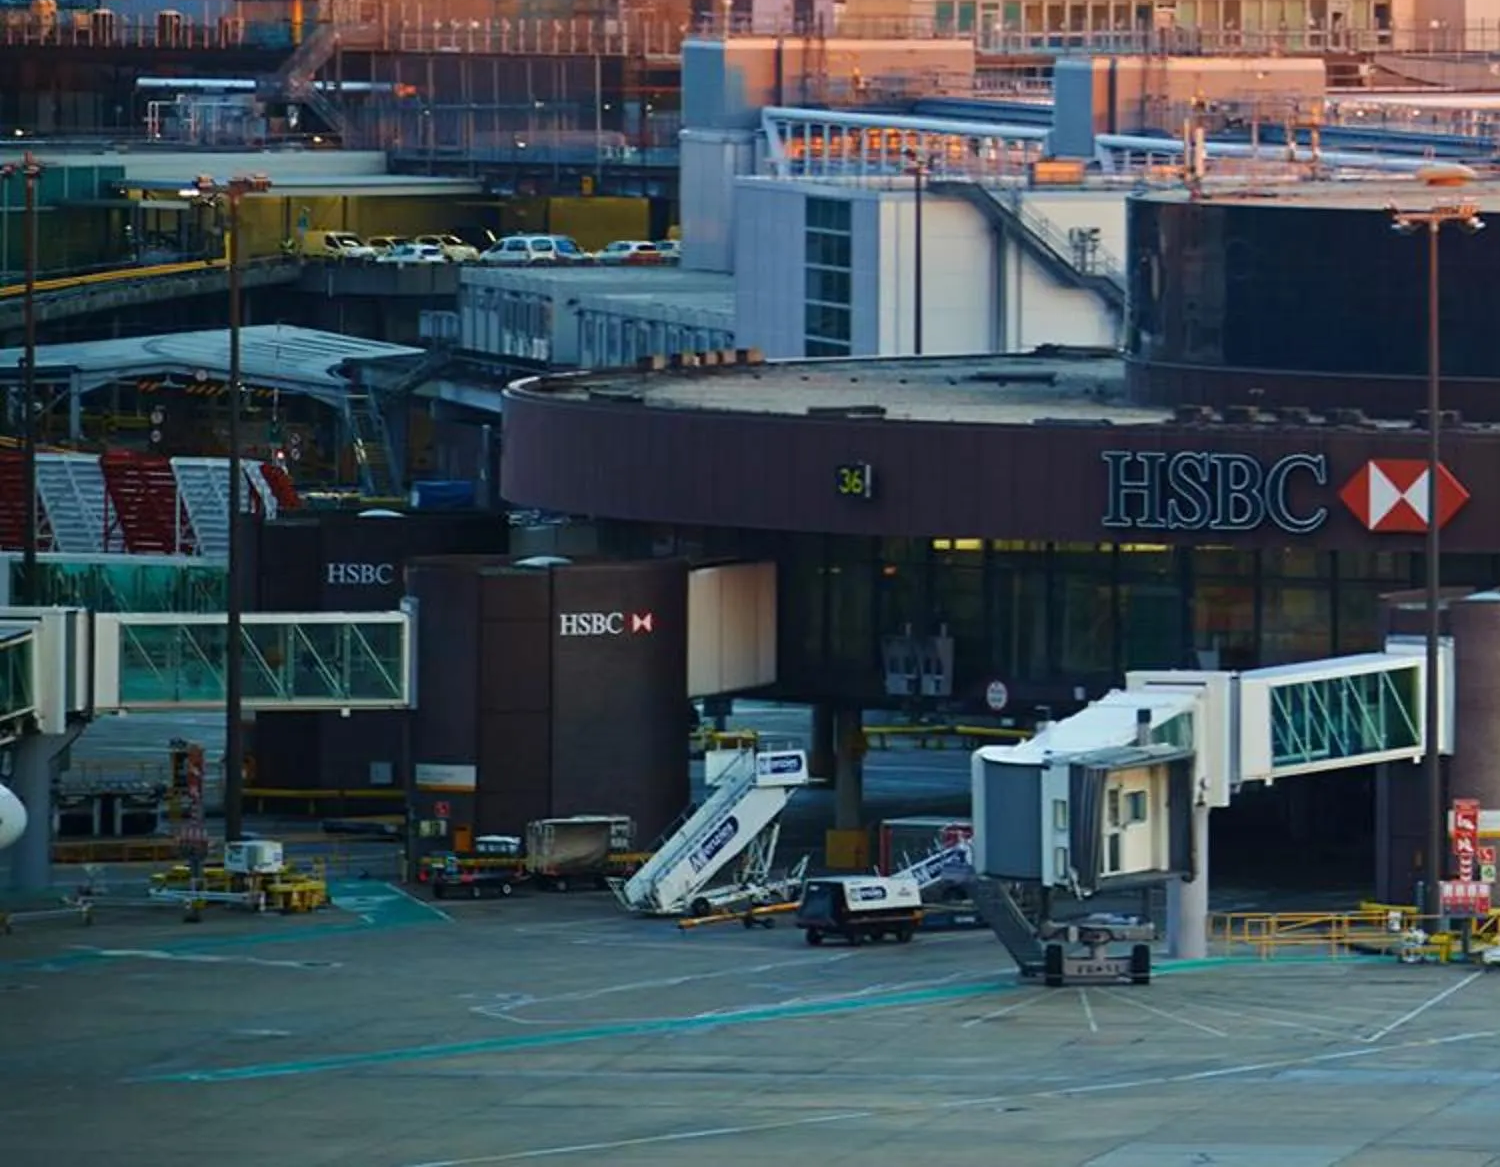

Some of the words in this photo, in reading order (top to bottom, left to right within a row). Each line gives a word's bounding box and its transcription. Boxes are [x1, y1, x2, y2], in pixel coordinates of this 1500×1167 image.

[839, 468, 863, 494] 36
[1101, 450, 1327, 533] HSBC
[327, 563, 394, 584] HSBC
[560, 612, 624, 636] HSBC
